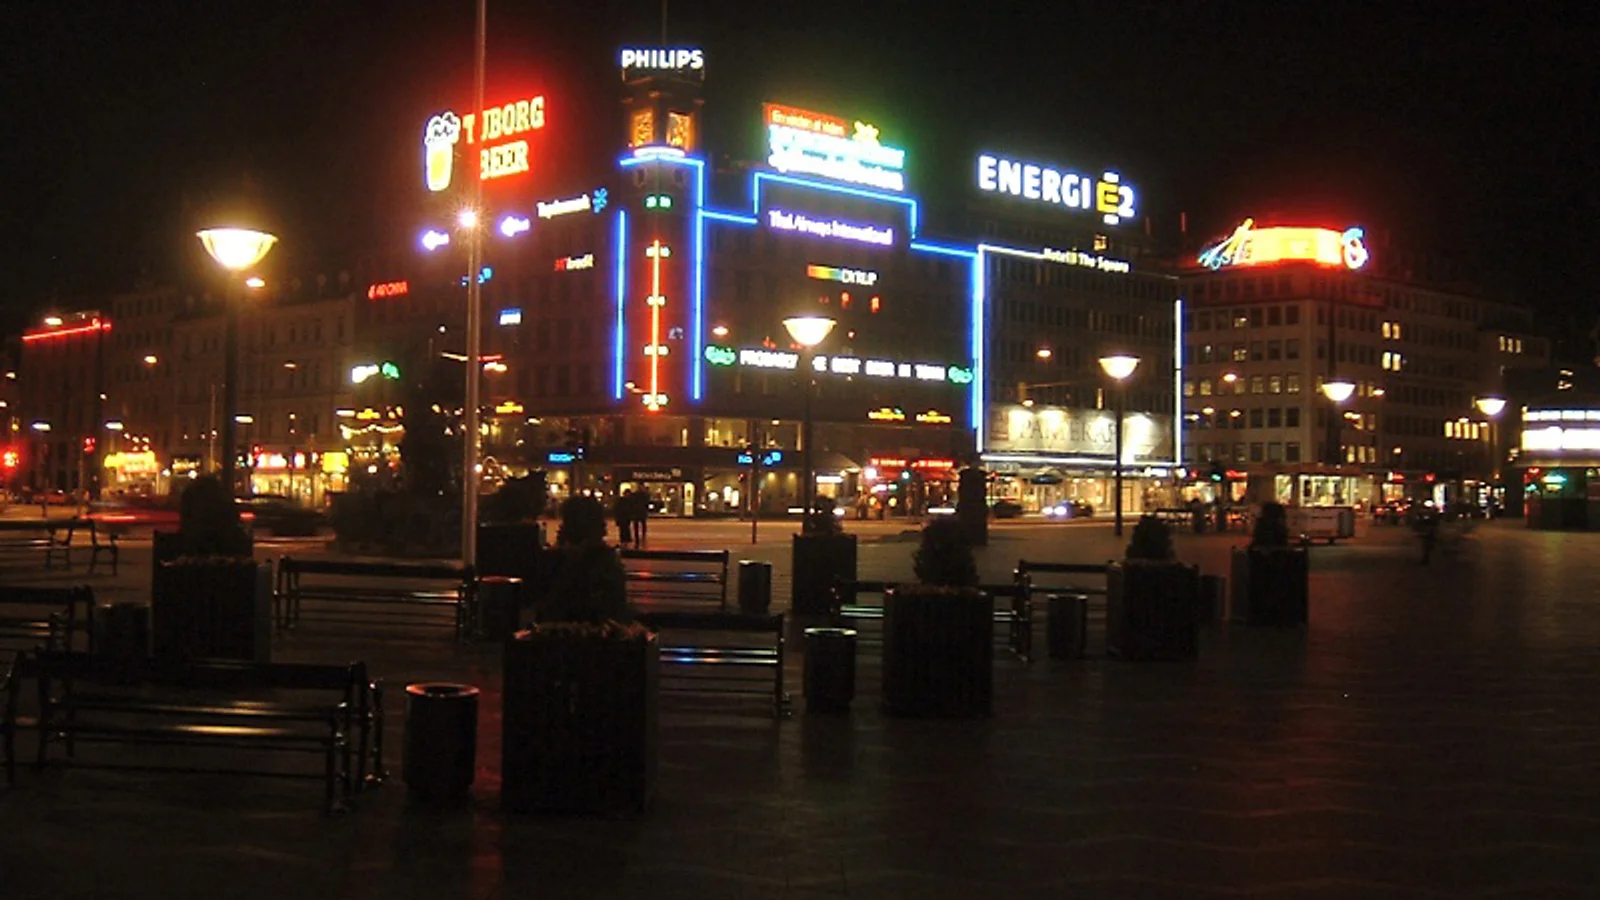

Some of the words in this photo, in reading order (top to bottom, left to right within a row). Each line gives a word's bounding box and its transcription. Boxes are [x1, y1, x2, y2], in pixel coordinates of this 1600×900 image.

[621, 50, 704, 69] PHILIPS
[480, 140, 529, 180] BEER
[978, 154, 1091, 209] ENERGI
[768, 210, 794, 230] Thai
